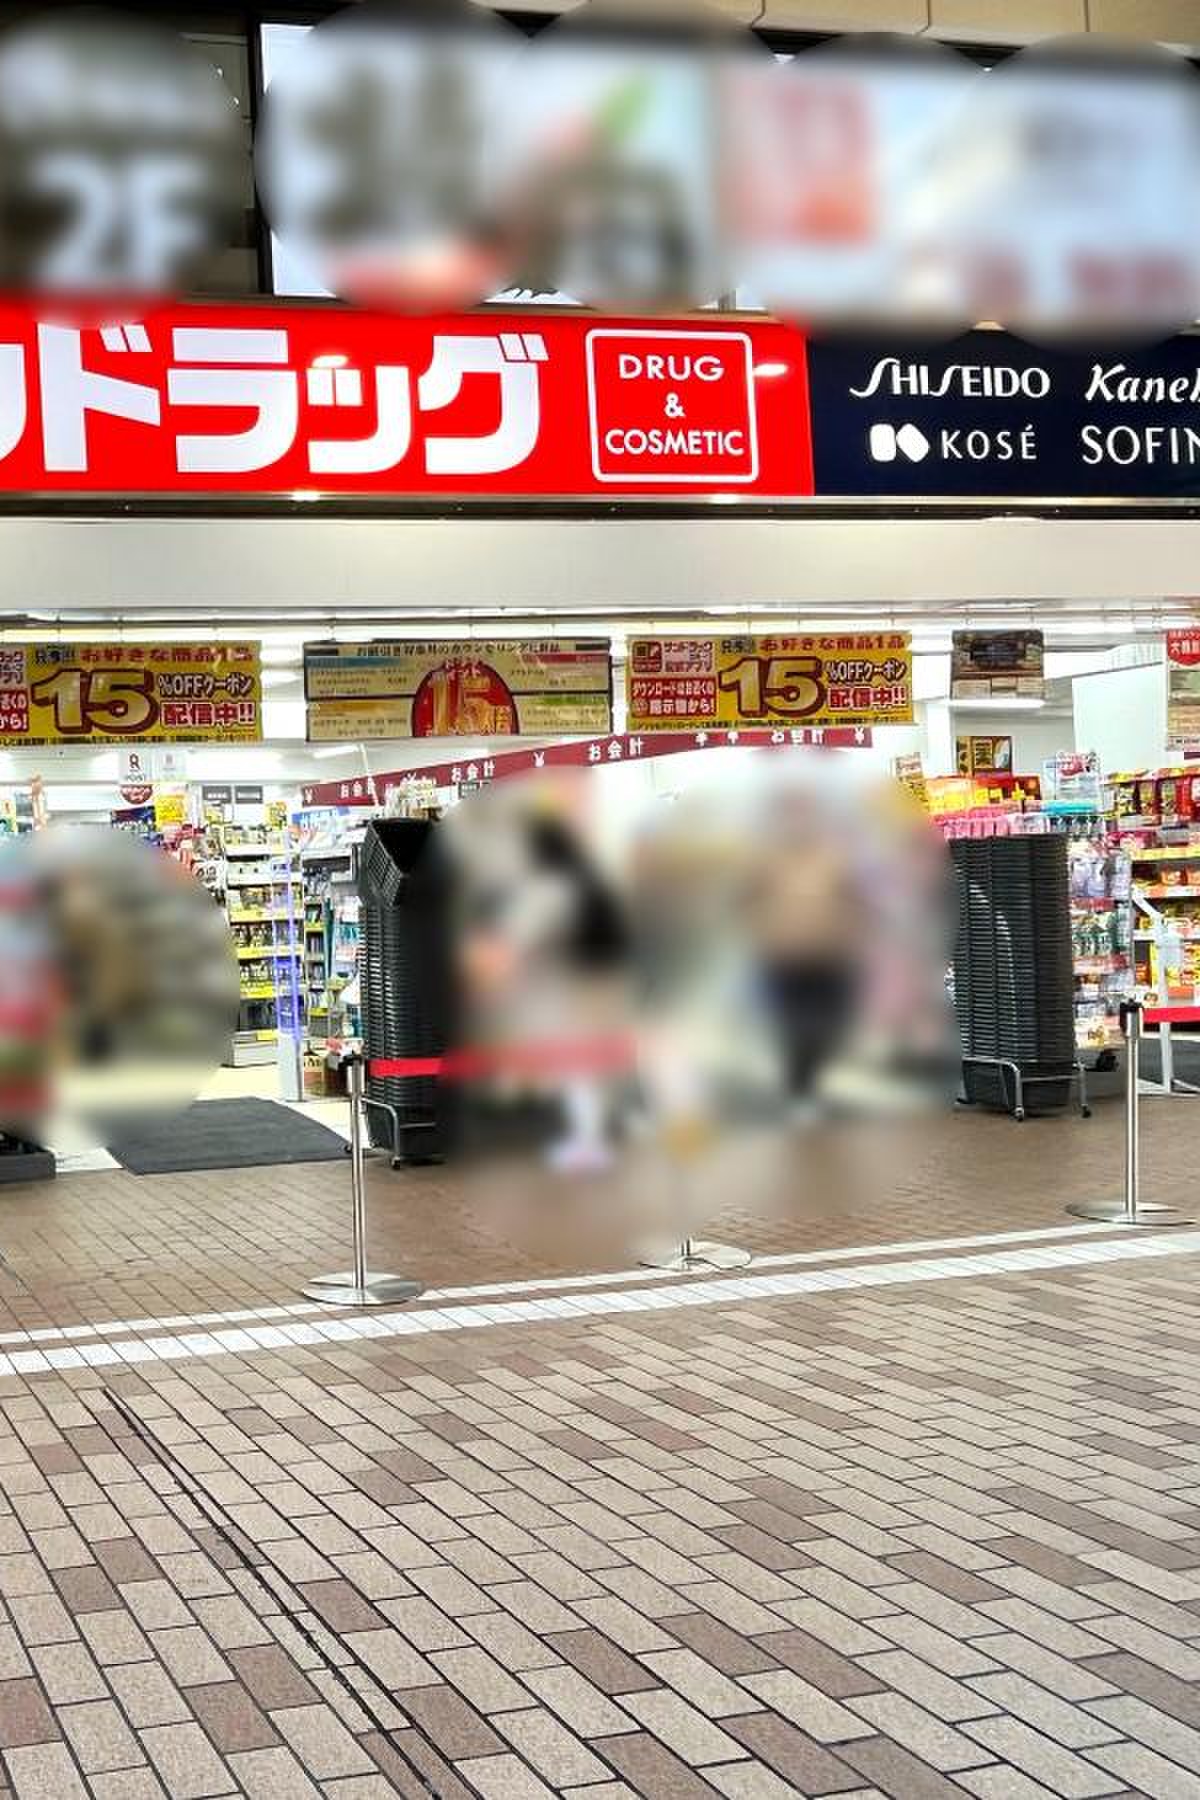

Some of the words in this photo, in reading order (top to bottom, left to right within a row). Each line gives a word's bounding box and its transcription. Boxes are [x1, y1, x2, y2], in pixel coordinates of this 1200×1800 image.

[618, 354, 725, 381] DRUG
[849, 358, 1051, 398] SHISEIDO
[663, 392, 687, 418] &
[604, 428, 745, 456] COSMETIC
[940, 424, 1038, 460] KOSÉ
[31, 667, 161, 735] 15
[718, 656, 827, 719] 15
[161, 701, 257, 728] 配信中!!
[588, 736, 645, 762] お会計
